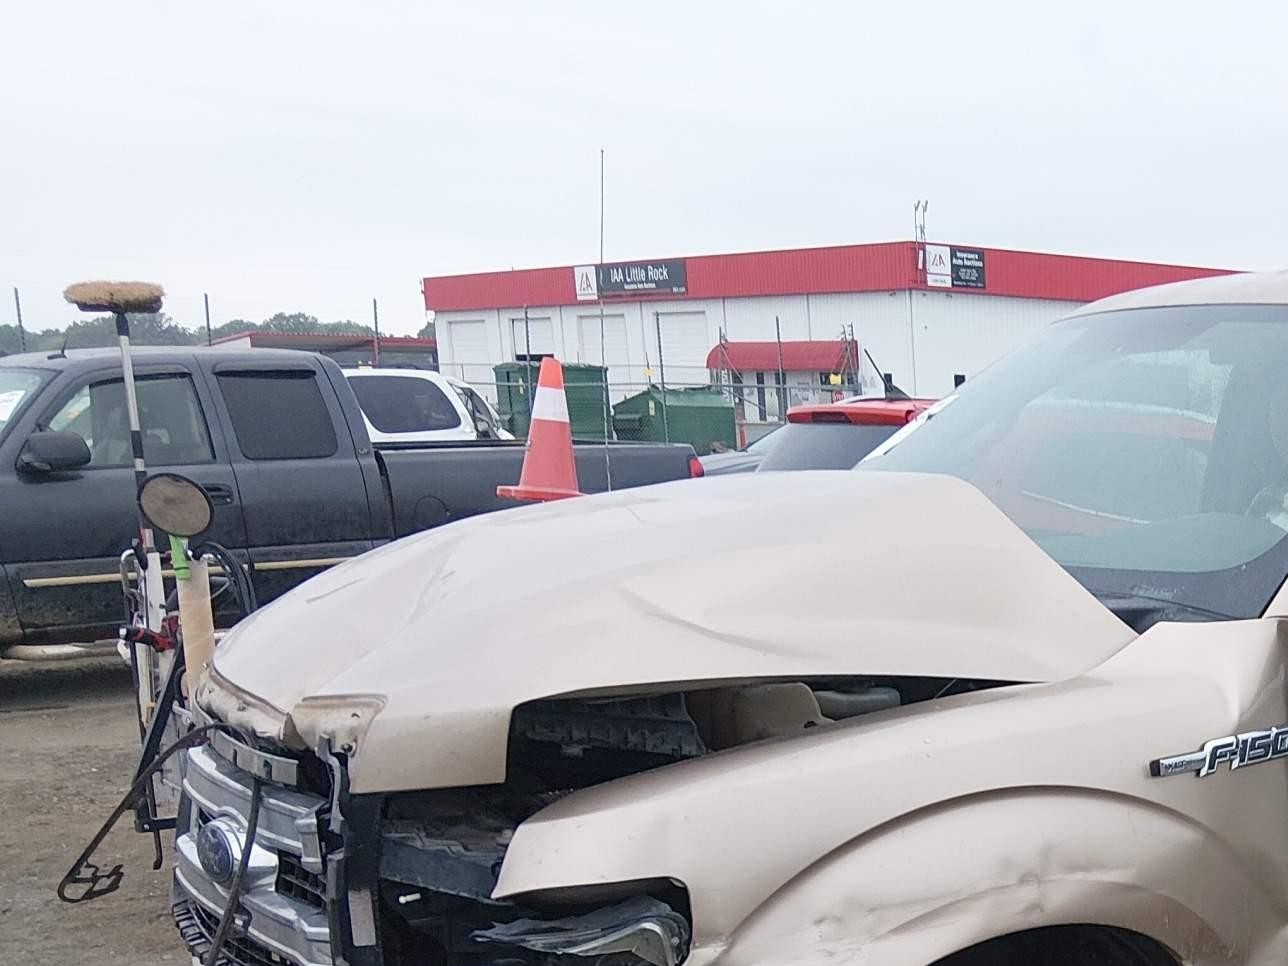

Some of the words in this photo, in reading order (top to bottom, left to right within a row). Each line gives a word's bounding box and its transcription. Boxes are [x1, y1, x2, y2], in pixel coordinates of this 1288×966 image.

[610, 268, 624, 282] IAA
[625, 265, 646, 281] Little
[647, 264, 669, 281] Rock
